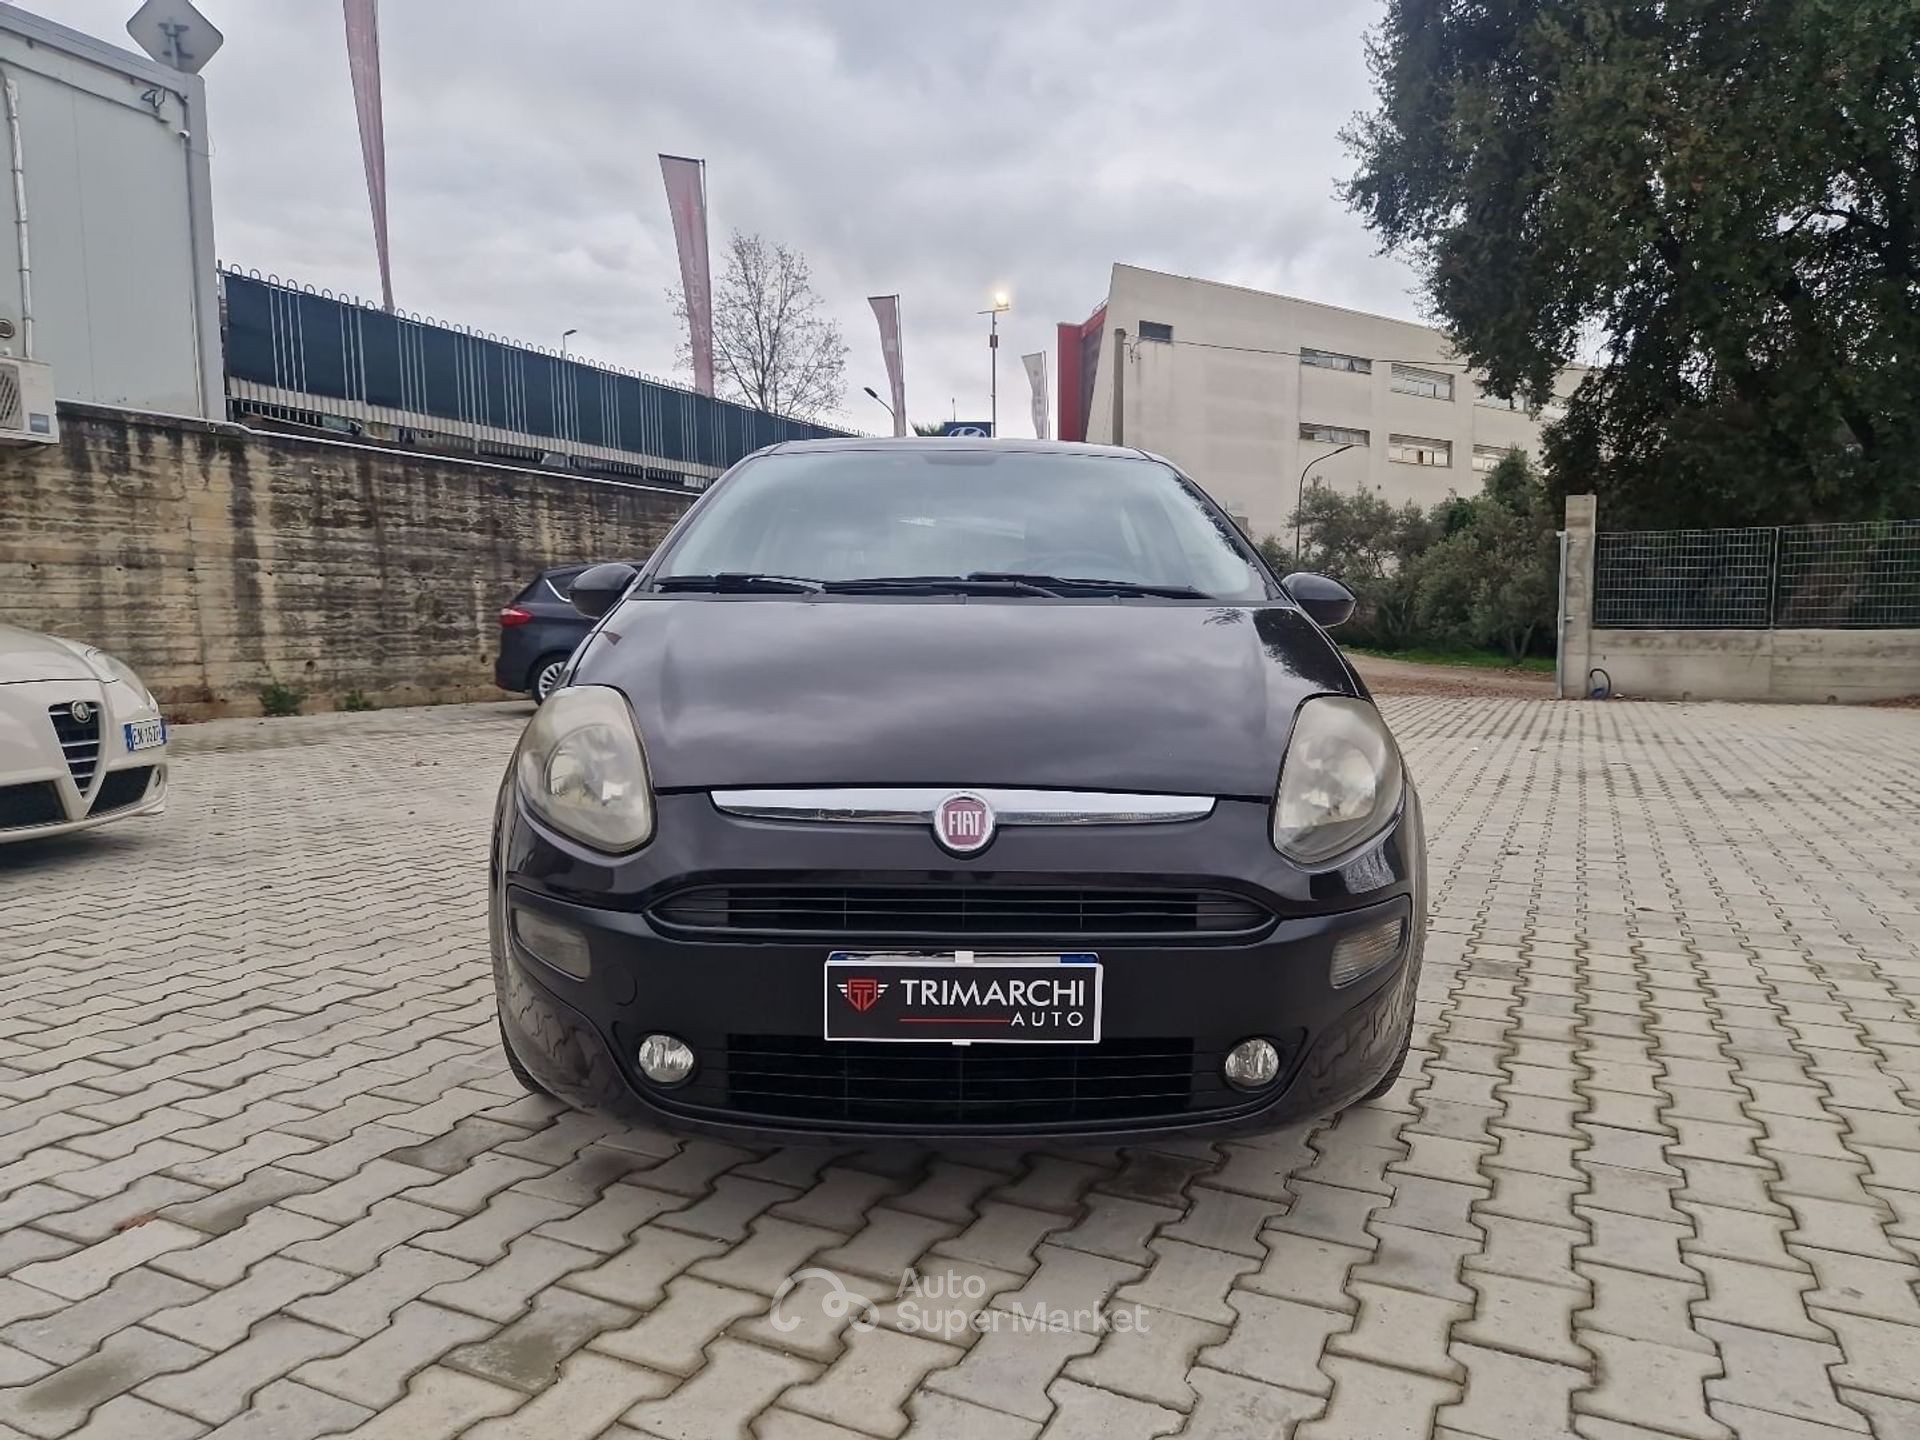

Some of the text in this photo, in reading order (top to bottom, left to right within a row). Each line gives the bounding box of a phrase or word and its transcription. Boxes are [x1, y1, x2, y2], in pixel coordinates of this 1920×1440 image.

[948, 811, 982, 836] FIAT
[900, 980, 1085, 1007] TRIMARCHI
[1011, 1012, 1084, 1027] AUTO
